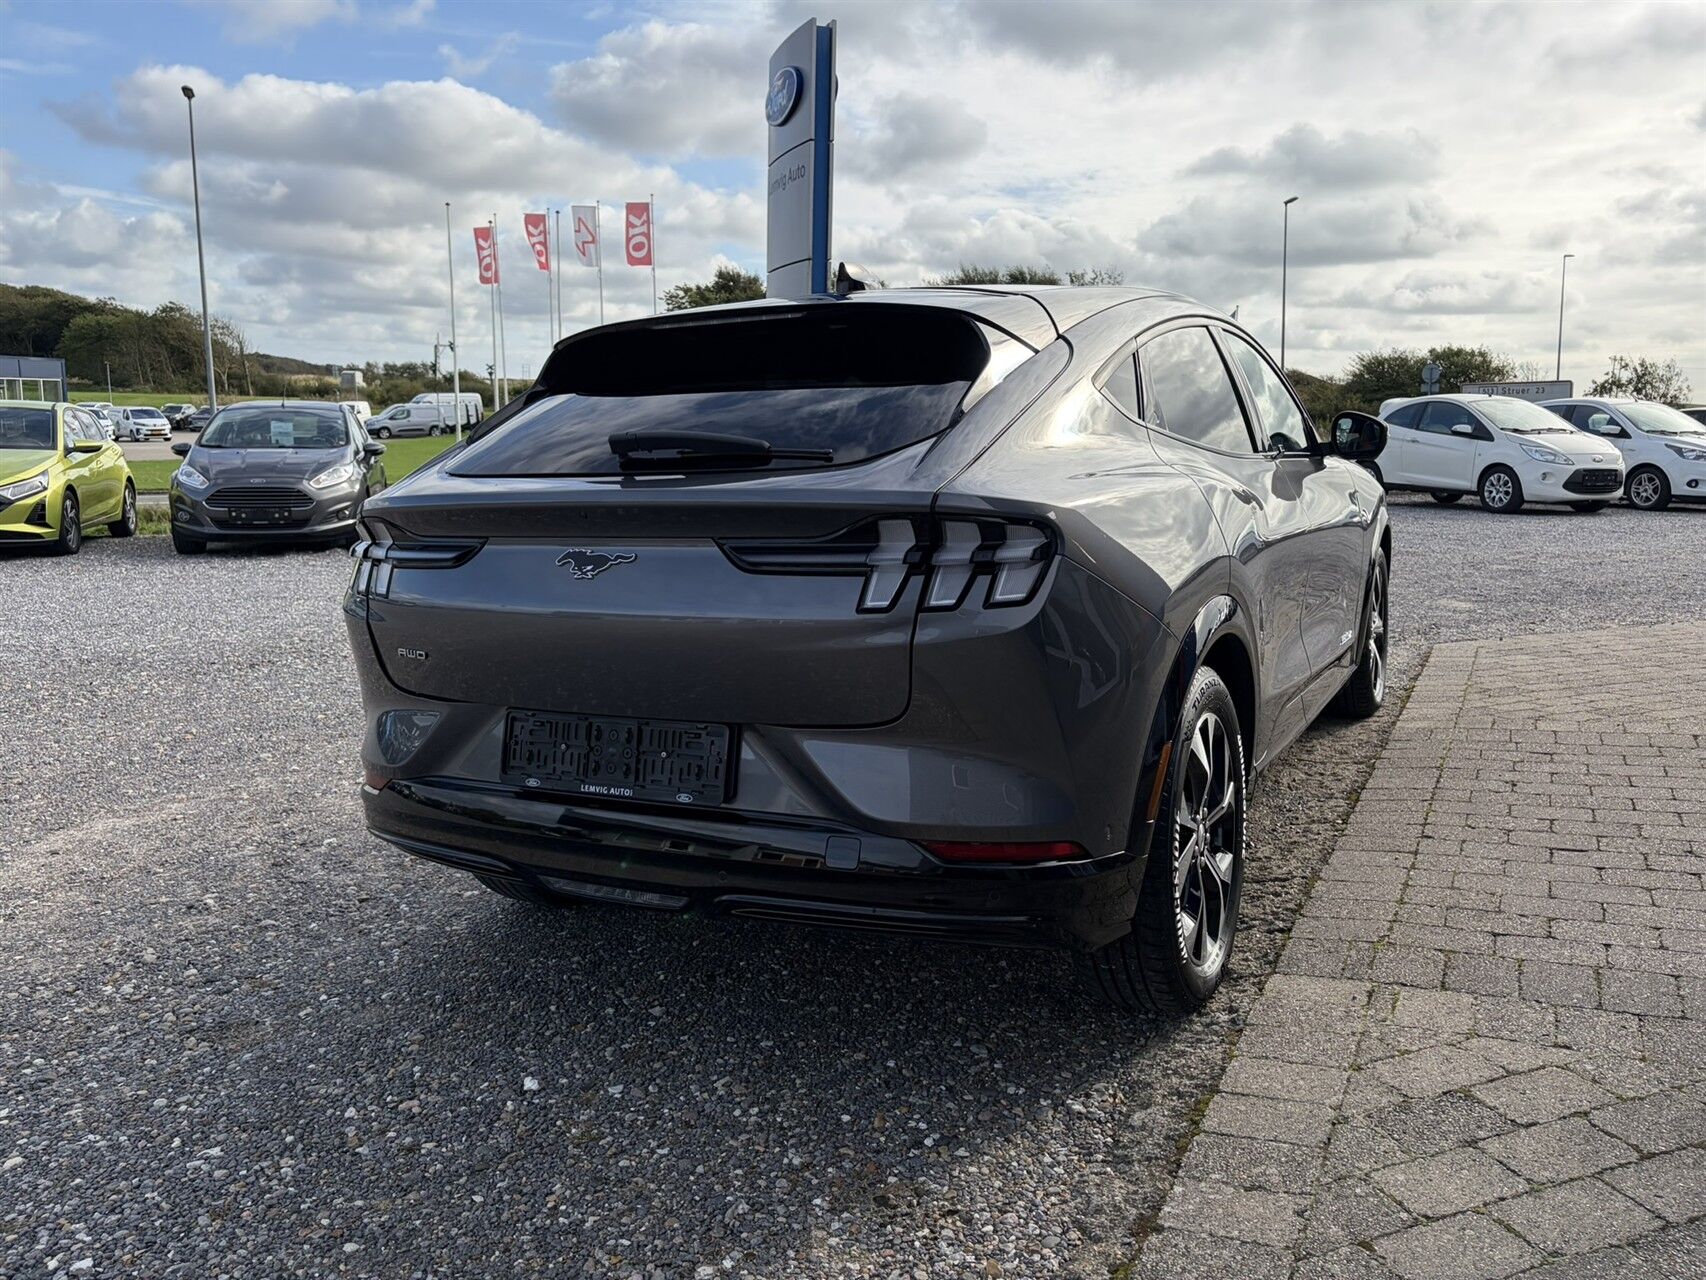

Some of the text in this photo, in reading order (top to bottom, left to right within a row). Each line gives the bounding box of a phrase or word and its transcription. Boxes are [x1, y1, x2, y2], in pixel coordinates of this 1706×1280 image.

[788, 163, 806, 184] Auto
[527, 223, 546, 263] OK
[628, 212, 649, 259] OK
[478, 237, 493, 278] OK
[1501, 386, 1530, 395] Struer
[1535, 386, 1545, 394] 23
[397, 647, 426, 660] AWD
[580, 784, 608, 794] LEMVIG
